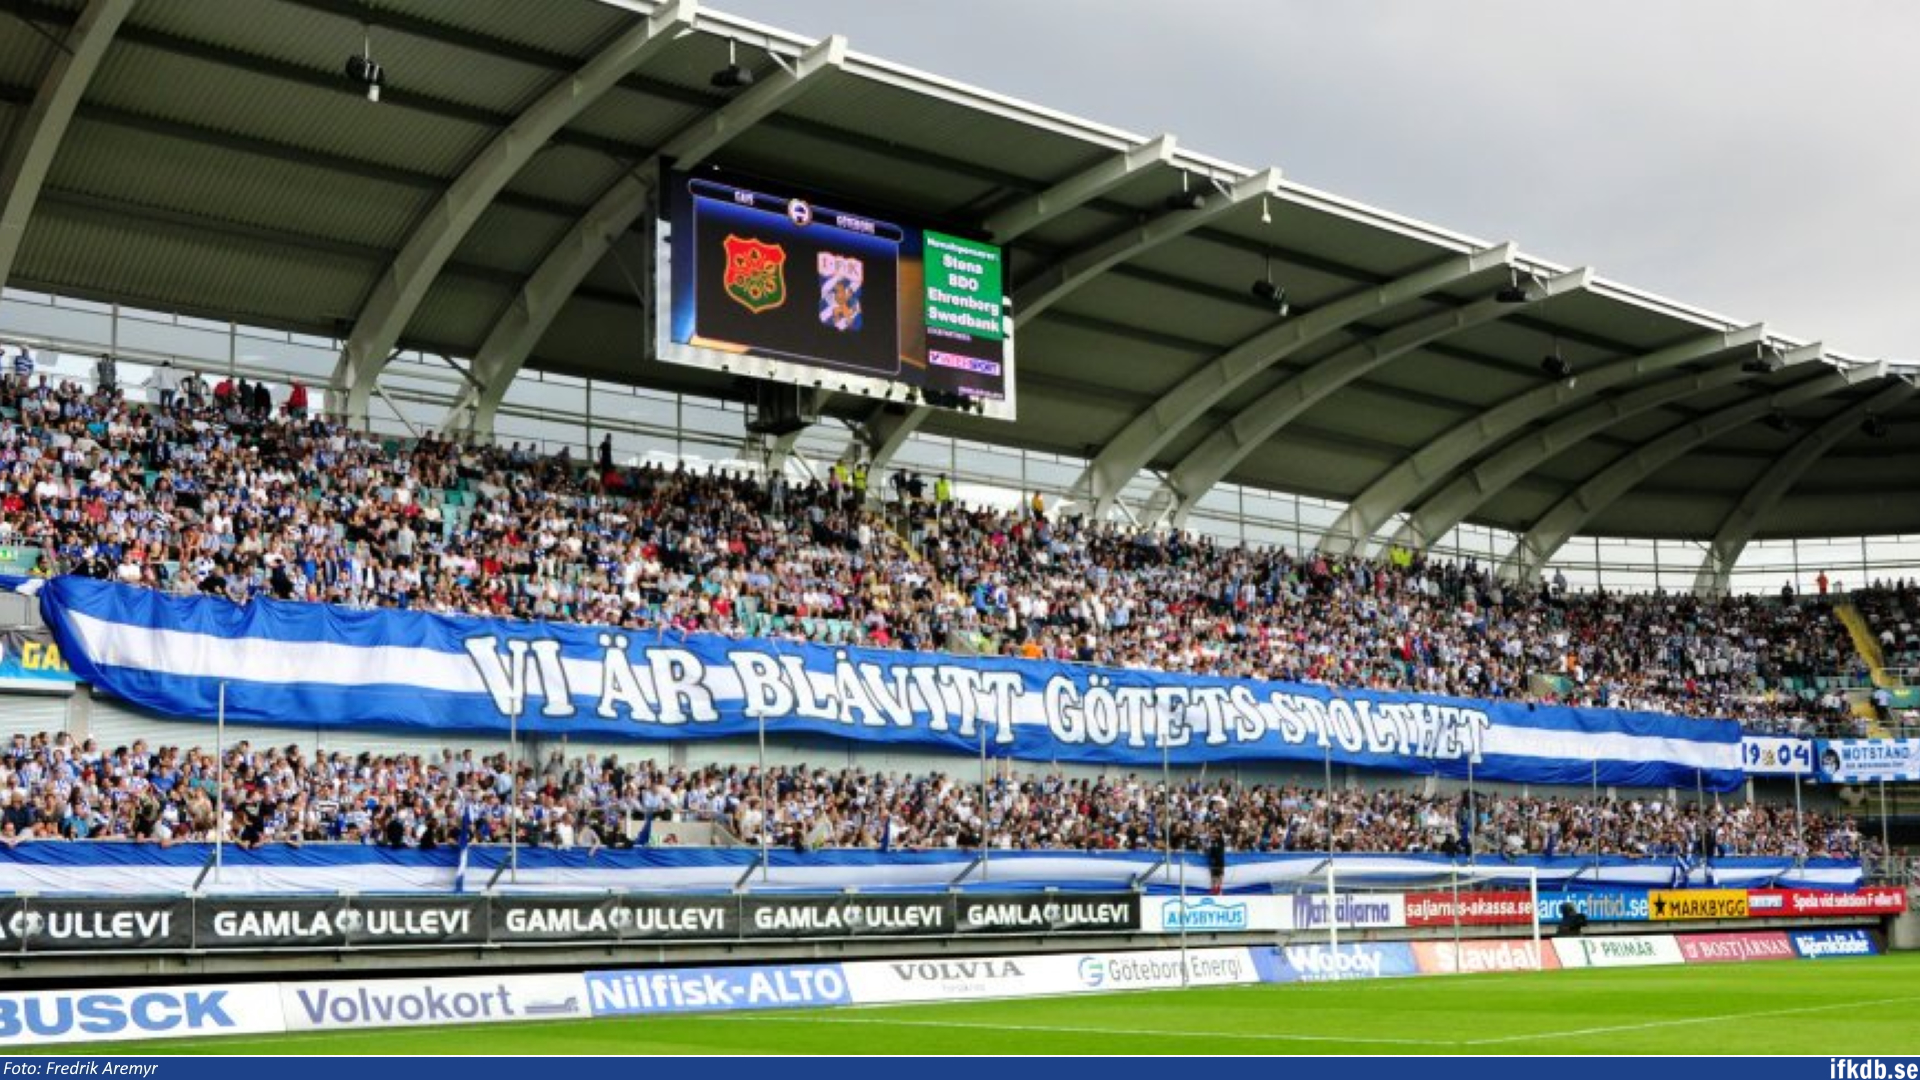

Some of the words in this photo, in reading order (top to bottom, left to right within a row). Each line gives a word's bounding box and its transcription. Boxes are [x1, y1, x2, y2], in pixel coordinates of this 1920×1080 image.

[942, 253, 984, 274] Stena
[948, 273, 979, 292] BDO
[927, 286, 999, 316] Ehrenborg
[928, 306, 999, 332] Swedbank
[463, 635, 577, 716] VI
[597, 634, 720, 725] ÄR
[728, 651, 1024, 743] BLÅVITT
[1043, 674, 1267, 747] GÖTETS
[1270, 691, 1489, 763] STOLTHET
[1742, 743, 1761, 765] 19
[1778, 744, 1809, 766] 04
[506, 908, 608, 932] GAMLA
[636, 907, 724, 930] ULLEVI
[755, 906, 842, 929] GAMLA
[865, 905, 943, 926] ULLEVI
[968, 904, 1043, 925] GAMLA
[1063, 903, 1130, 923] ULLEVI
[1669, 899, 1746, 917] MARKBYGG
[49, 910, 172, 938] ULLEVI
[214, 910, 333, 937] GAMLA
[367, 909, 471, 934] ULLEVI
[890, 960, 1025, 981] VOLVIA
[1109, 957, 1189, 983] Göteborg
[1191, 955, 1242, 980] Energi
[1286, 943, 1382, 977] Woody
[590, 968, 845, 1010] Nilfisk-ALTO
[297, 984, 514, 1024] Volvokort
